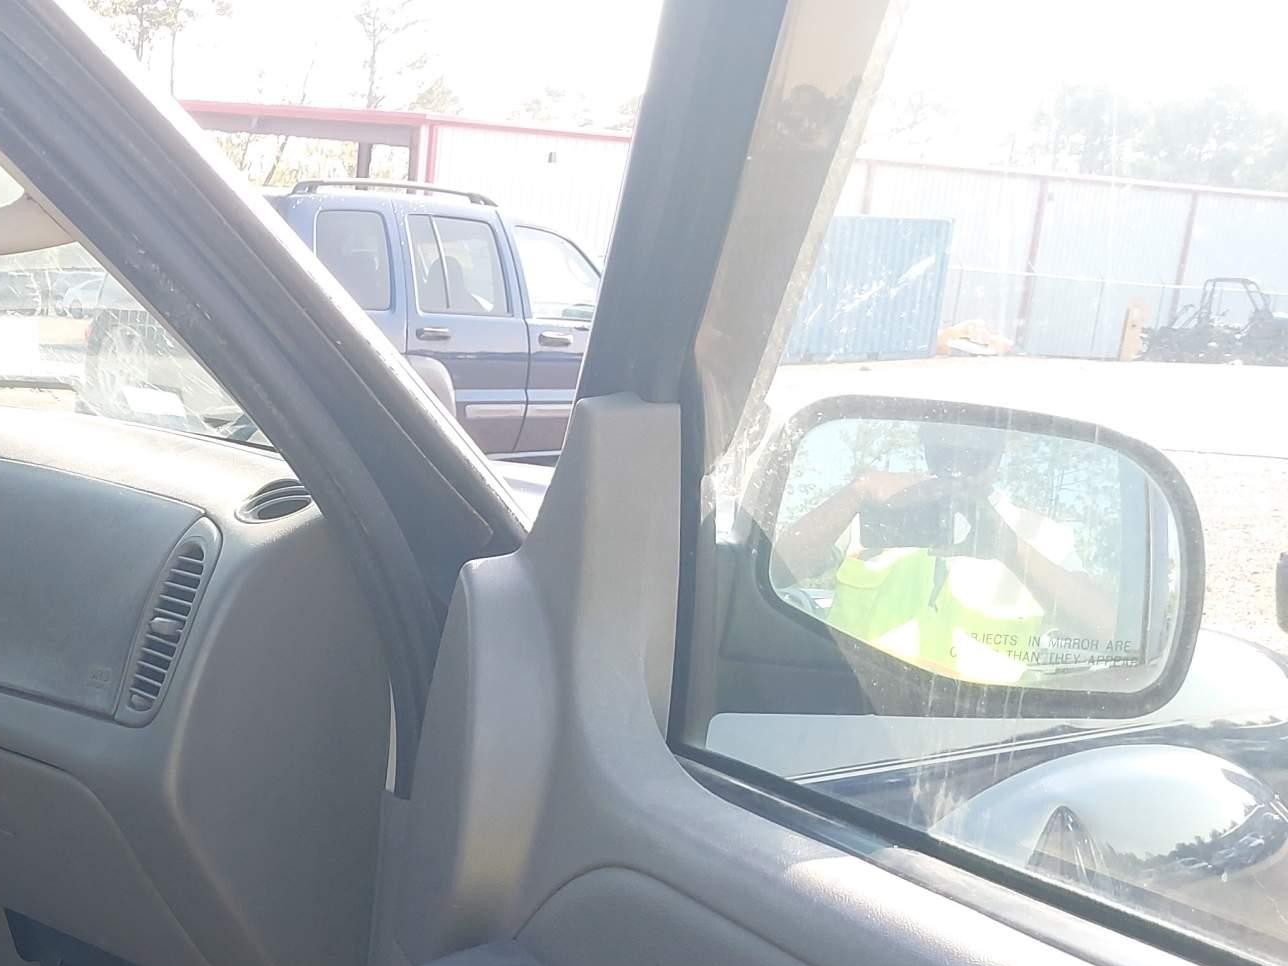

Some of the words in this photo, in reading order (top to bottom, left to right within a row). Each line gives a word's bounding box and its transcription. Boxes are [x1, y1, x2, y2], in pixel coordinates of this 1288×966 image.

[1028, 634, 1041, 648] IN
[1048, 636, 1099, 651] MIRROR
[1105, 639, 1133, 654] ARE
[1007, 649, 1040, 665] THAN
[1048, 651, 1081, 665] THEY
